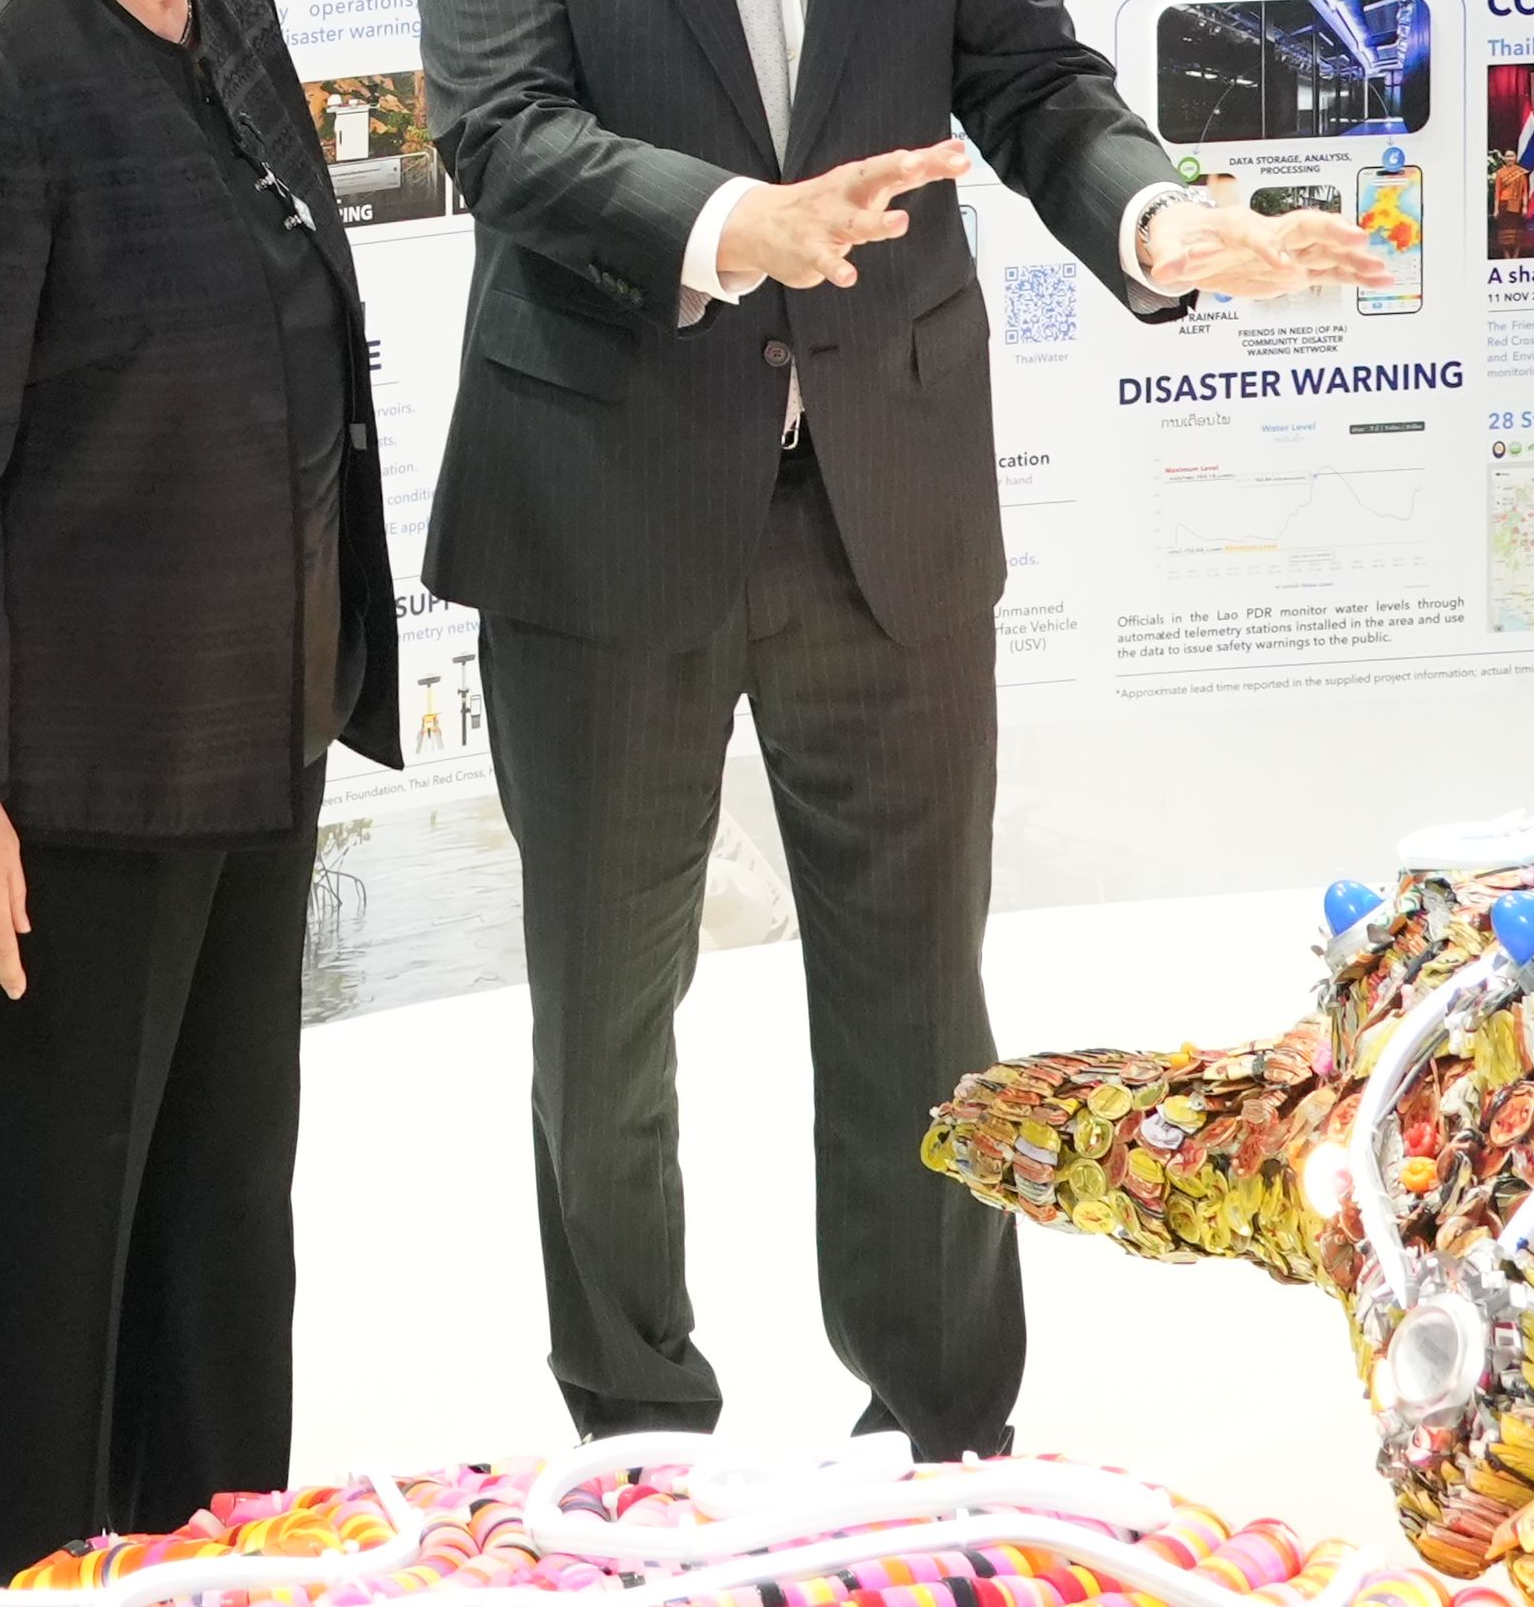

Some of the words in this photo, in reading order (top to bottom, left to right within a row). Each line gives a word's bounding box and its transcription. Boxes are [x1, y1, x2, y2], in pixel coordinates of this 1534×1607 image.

[1487, 267, 1503, 285] A
[1487, 293, 1500, 303] 11
[1503, 291, 1530, 302] NOV
[1013, 352, 1070, 365] ThaiWater
[1119, 370, 1282, 406] DISASTER
[1290, 360, 1463, 396] WARNING
[1488, 411, 1514, 431] 28
